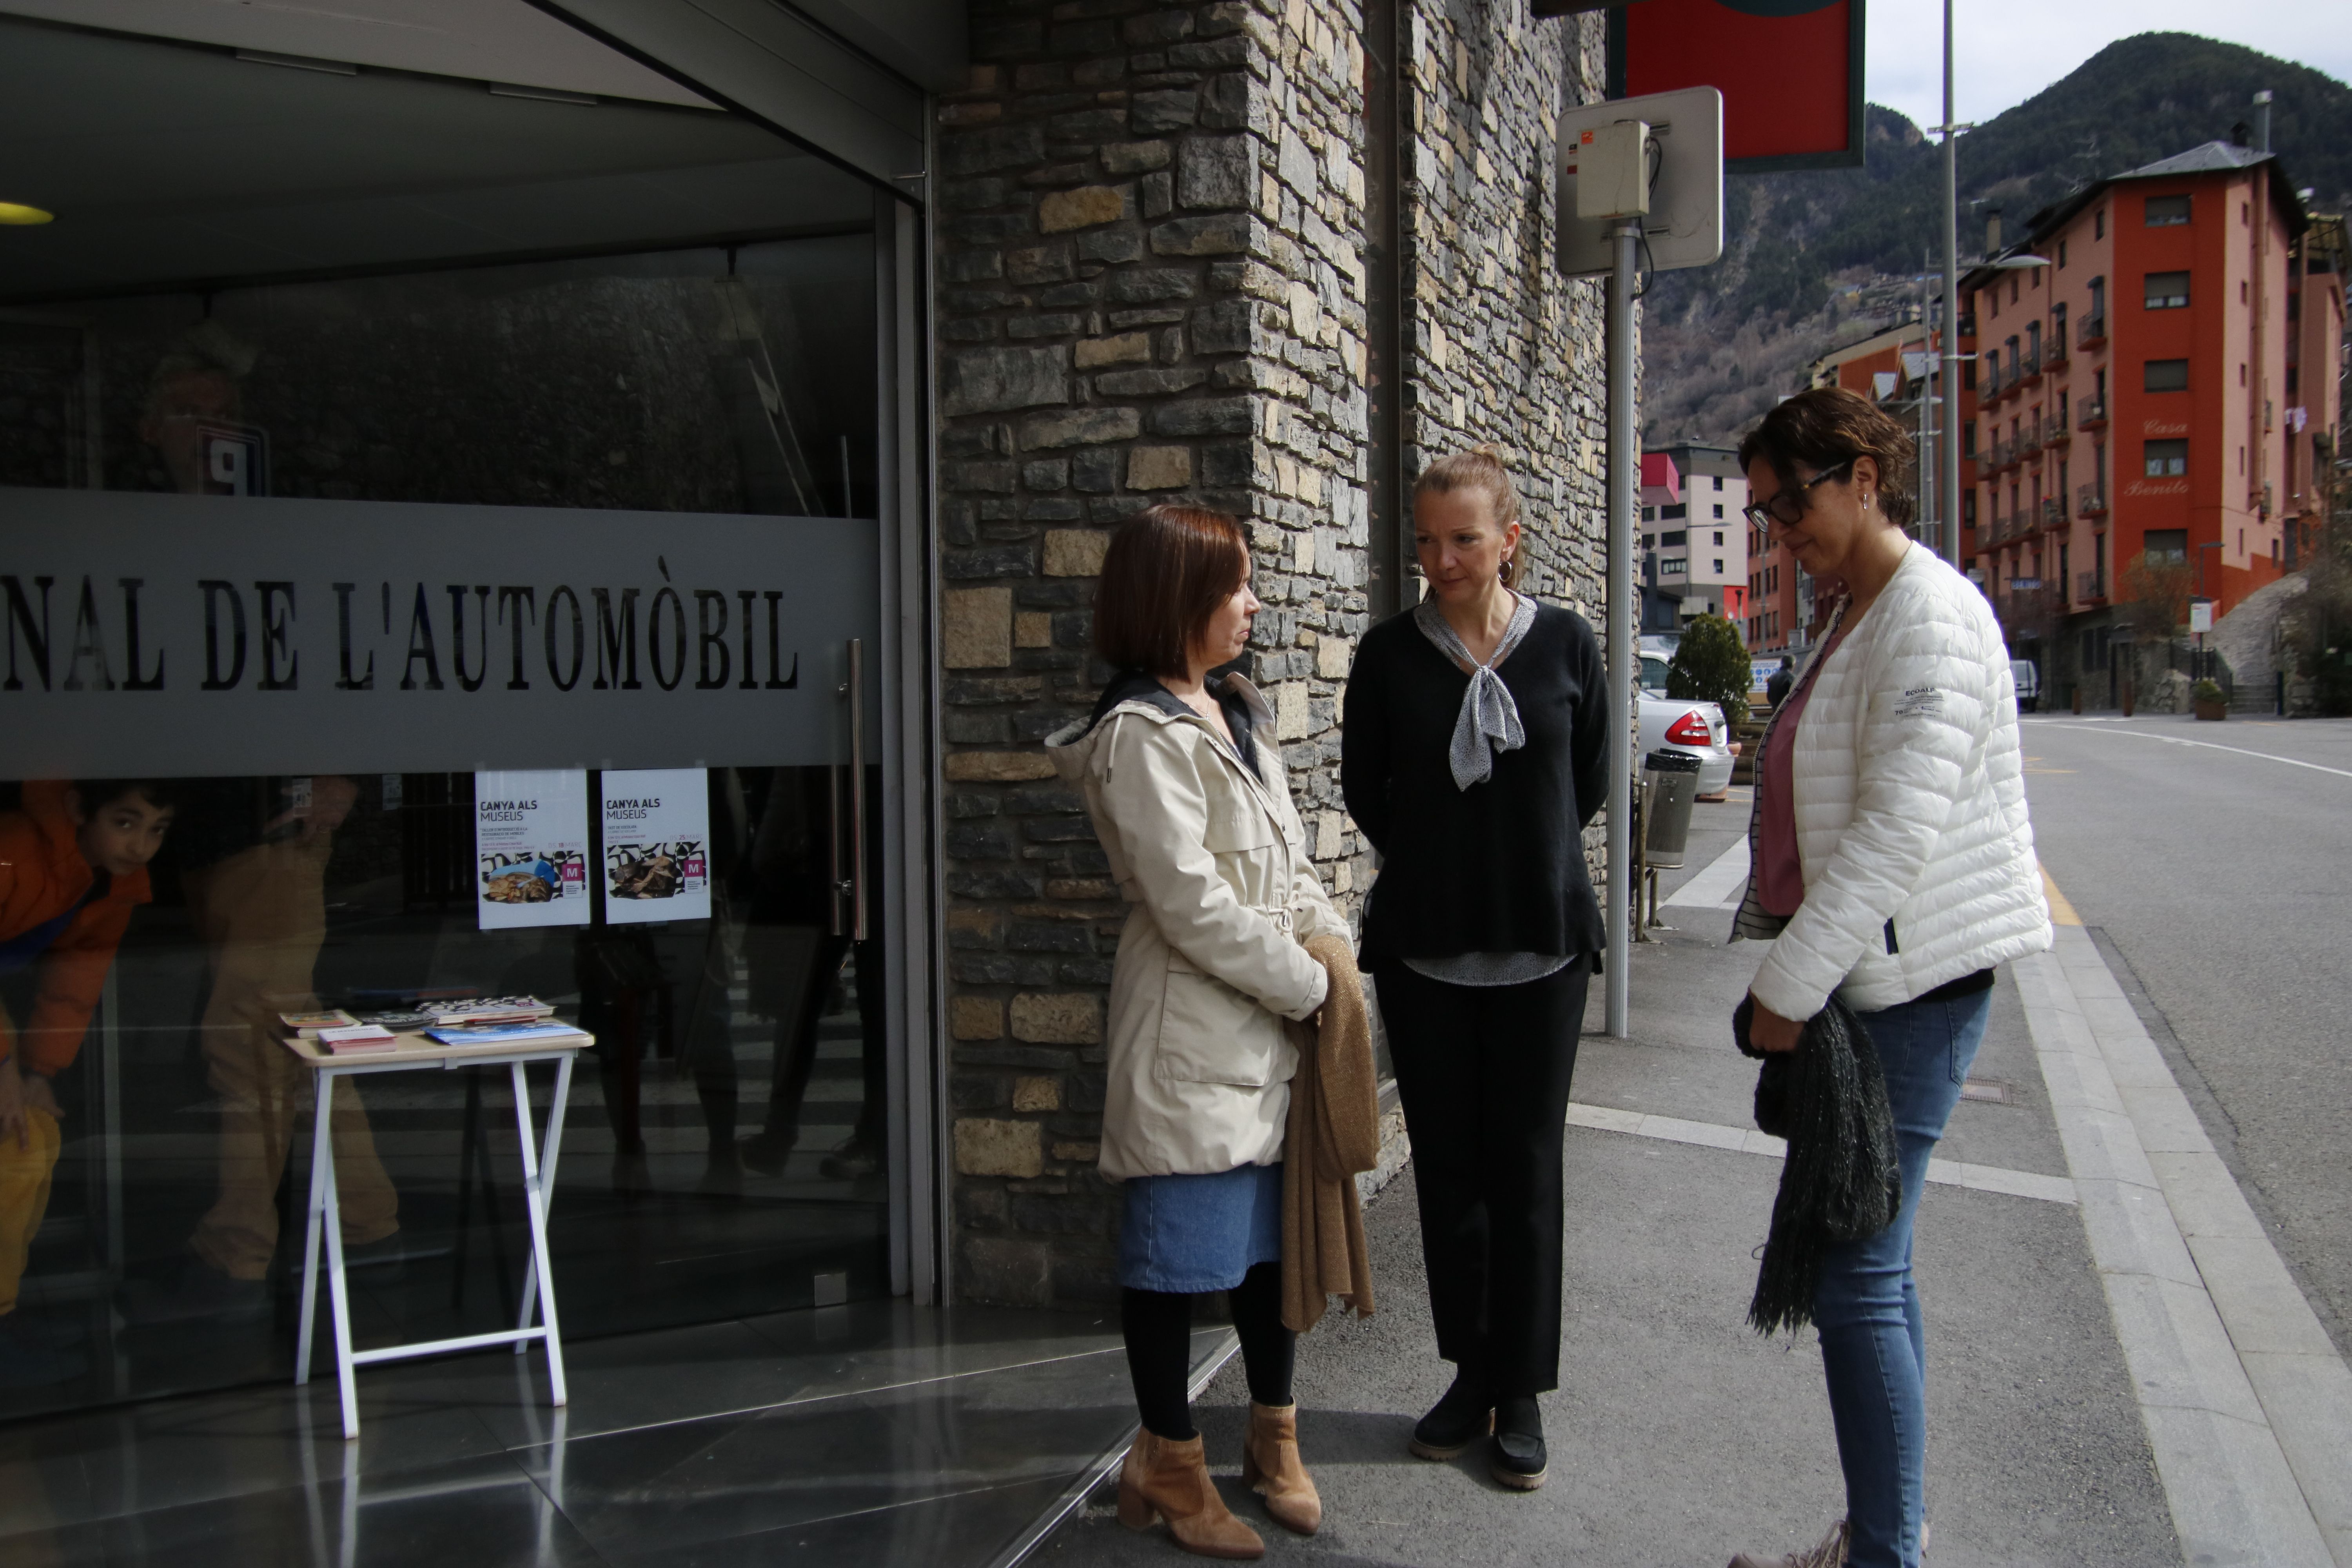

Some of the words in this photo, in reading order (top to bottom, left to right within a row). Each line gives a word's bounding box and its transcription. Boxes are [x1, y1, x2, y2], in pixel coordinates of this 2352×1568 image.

[2143, 419, 2187, 435] Casa
[2124, 480, 2189, 496] Benito
[0, 575, 164, 691] NAL
[197, 580, 298, 691] DE
[332, 555, 798, 692] L'AUTOMÒBIL
[1906, 687, 1935, 696] ECOALF
[480, 801, 515, 811] CANYA
[517, 800, 537, 810] ALS
[606, 800, 639, 809] CANYA
[641, 799, 660, 808] ALS
[481, 811, 523, 822] MUSEUS
[606, 809, 646, 820] MUSEUS
[567, 868, 577, 877] M
[688, 864, 699, 873] M
